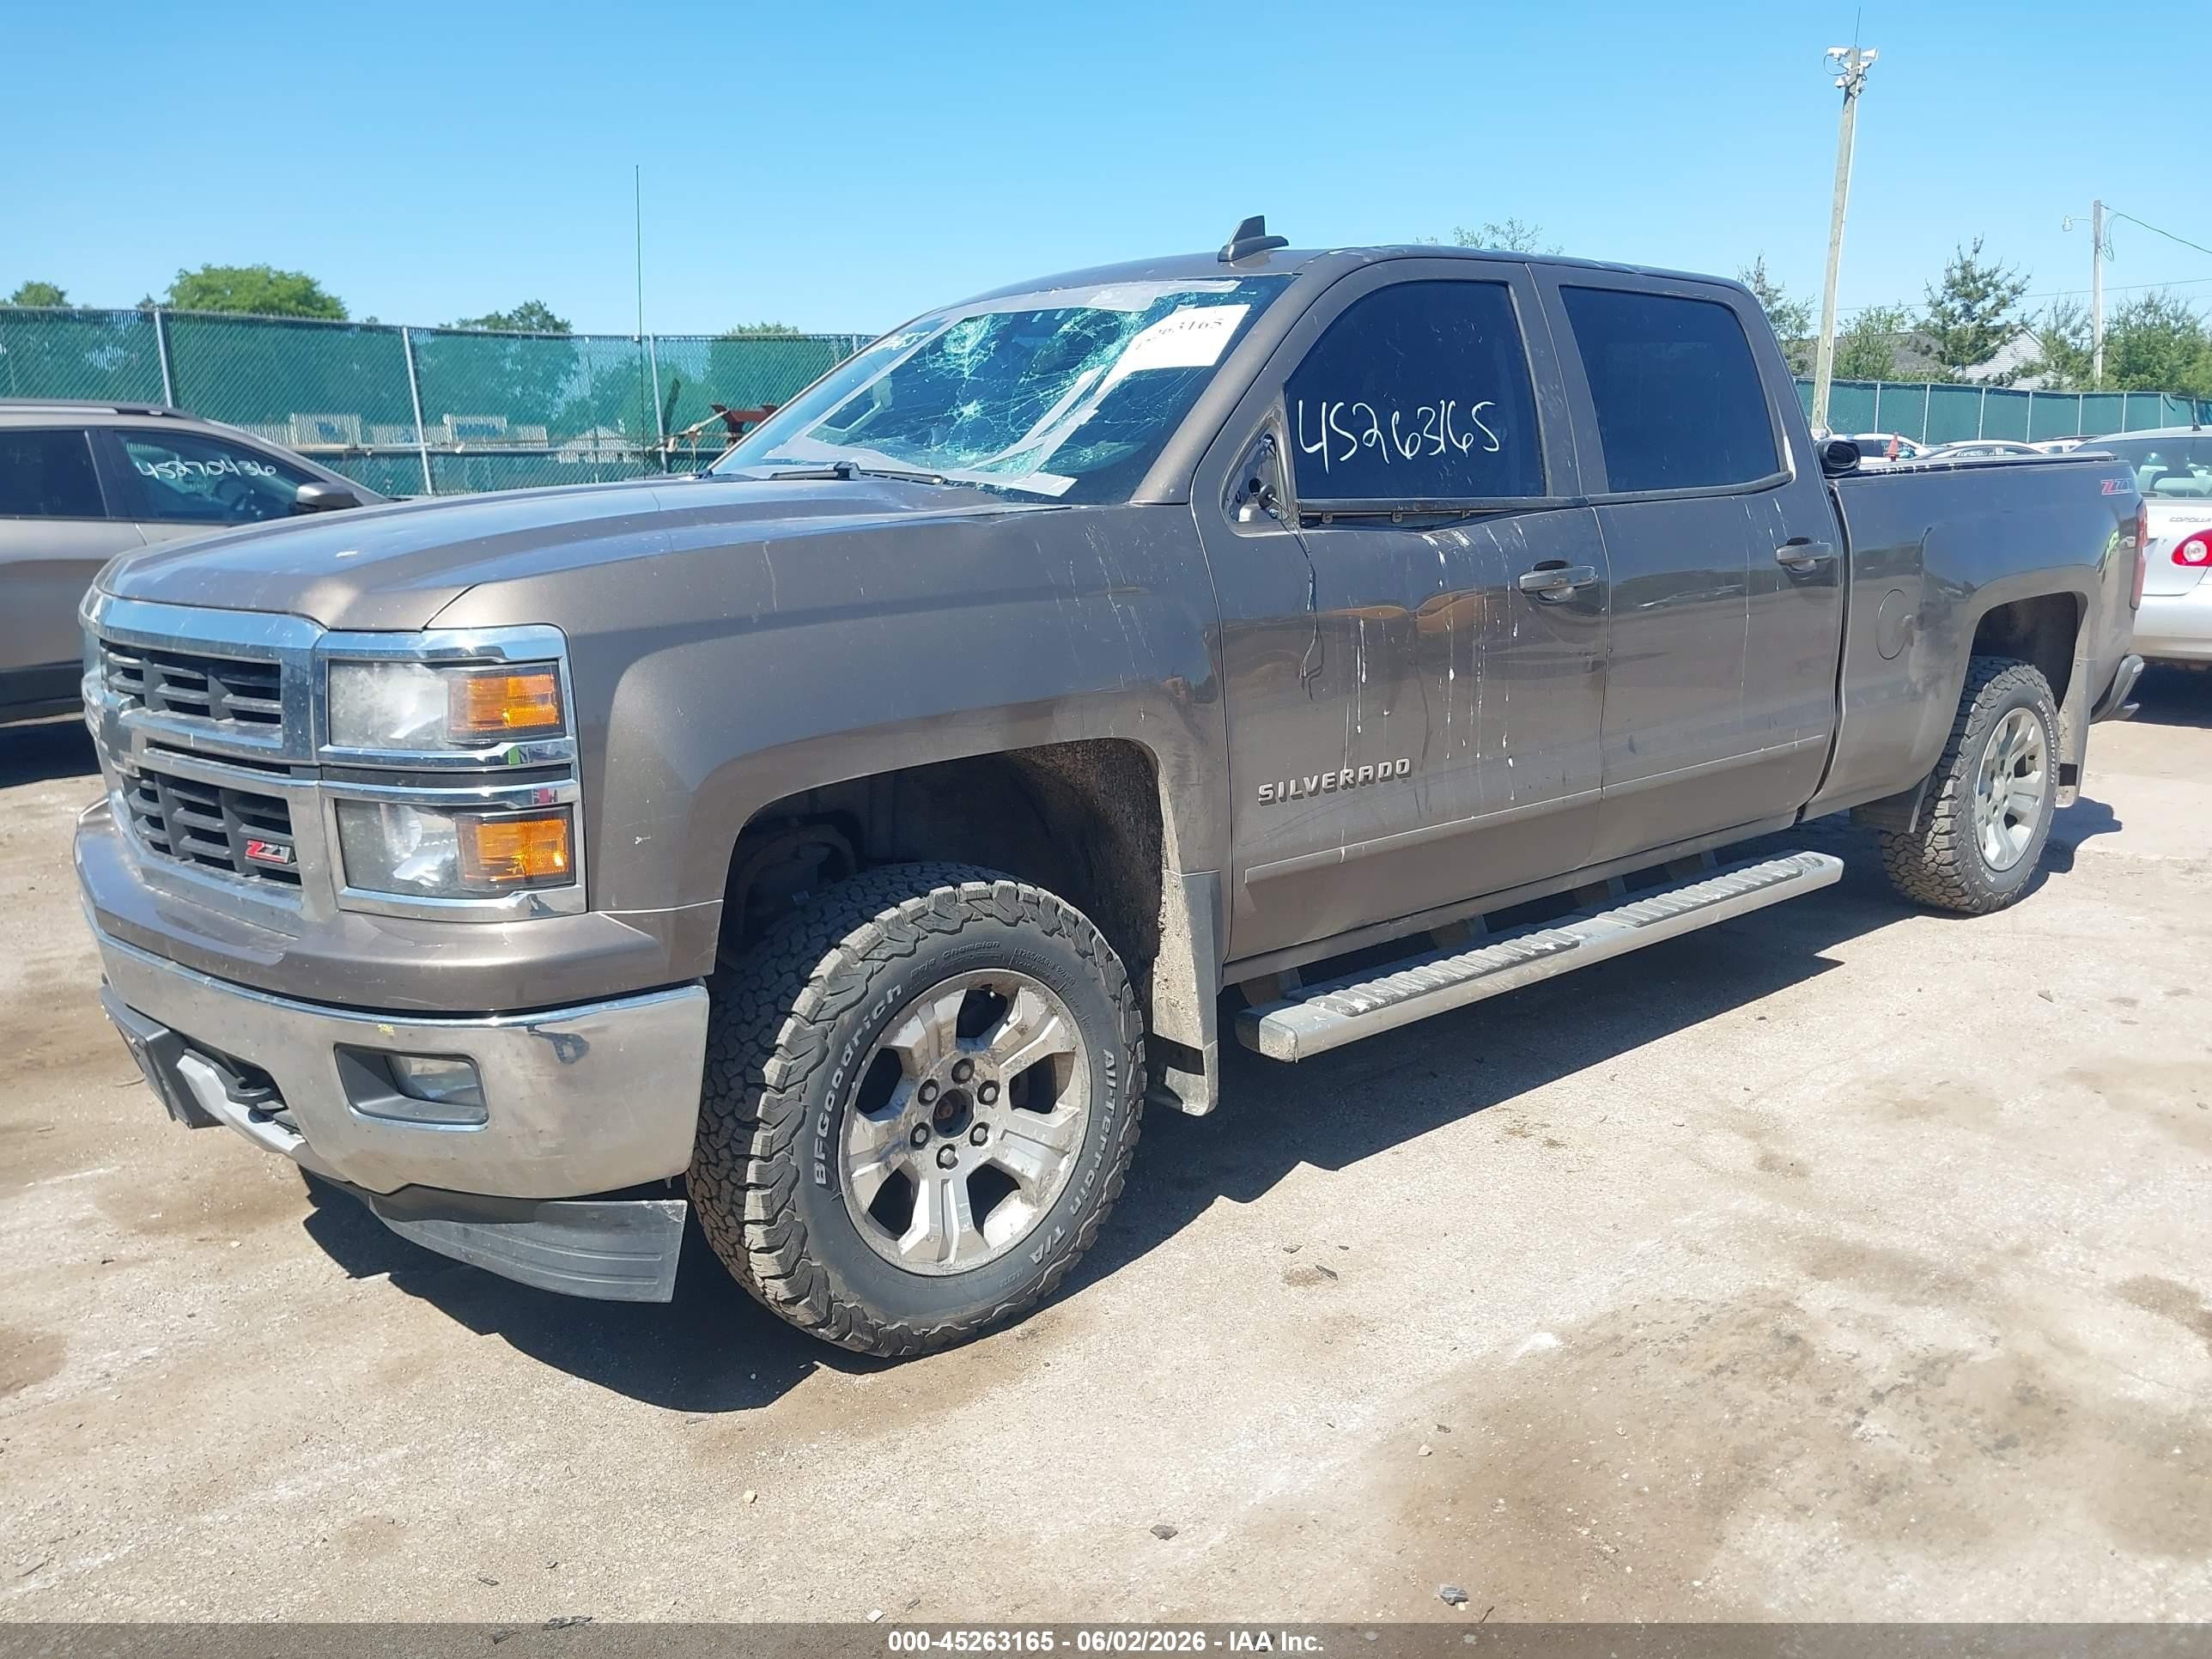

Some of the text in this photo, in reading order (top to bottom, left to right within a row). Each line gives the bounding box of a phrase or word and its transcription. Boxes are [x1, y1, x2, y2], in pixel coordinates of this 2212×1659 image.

[1297, 398, 1501, 474] 45263165
[136, 459, 277, 480] 45270436
[2100, 478, 2134, 495] Z71
[1258, 758, 1411, 805] SILVERADO
[245, 839, 293, 865] Z71
[813, 985, 902, 1185] BFGoodrich
[1070, 1049, 1117, 1216] All-Terrain
[1029, 1224, 1066, 1265] T/A
